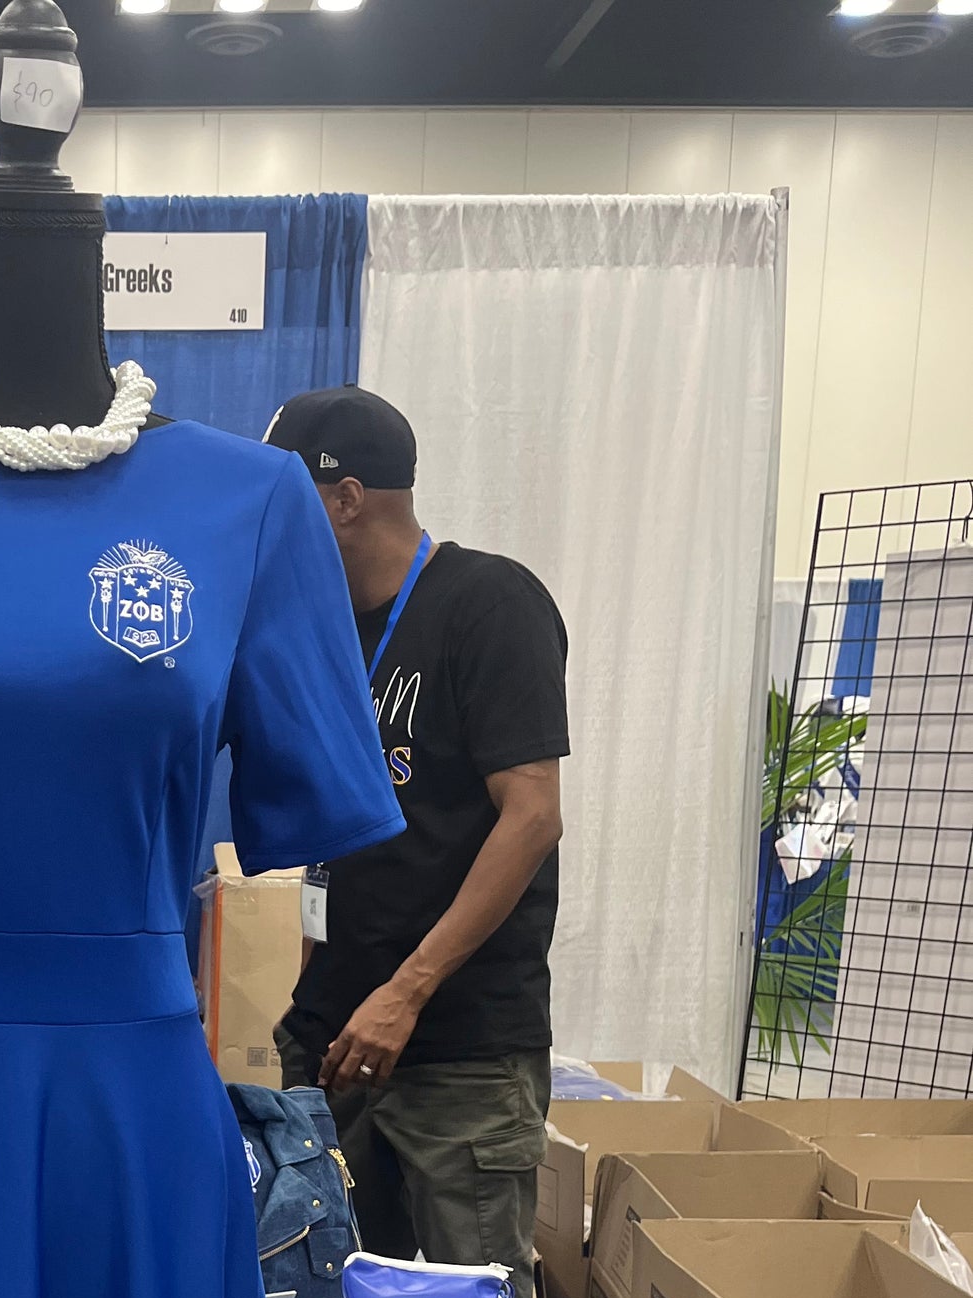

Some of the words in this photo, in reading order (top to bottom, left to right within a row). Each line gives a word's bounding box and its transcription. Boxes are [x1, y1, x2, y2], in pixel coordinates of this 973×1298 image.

[12, 70, 54, 113] $90
[103, 262, 173, 293] Greeks
[229, 308, 248, 323] 410
